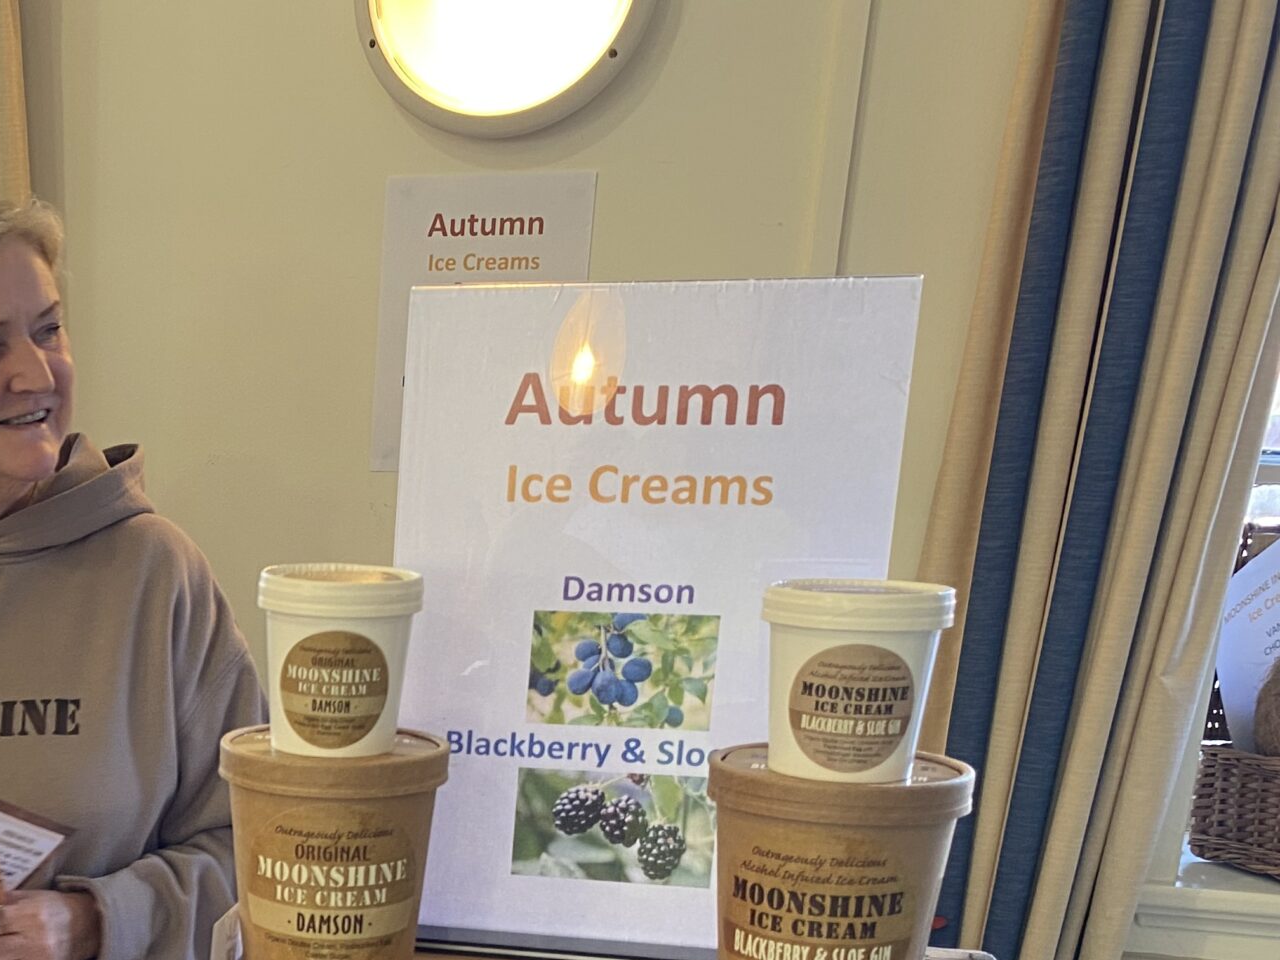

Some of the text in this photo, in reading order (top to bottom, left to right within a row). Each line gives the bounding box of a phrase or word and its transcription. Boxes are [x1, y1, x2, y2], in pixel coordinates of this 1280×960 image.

[427, 213, 545, 237] Autumn
[428, 253, 540, 271] Ice Creams
[504, 371, 787, 426] Autumn
[506, 464, 774, 506] Ice Creams
[562, 576, 695, 606] Damson
[1224, 580, 1271, 624] MOONSHINE
[311, 656, 355, 667] ORIGINAL
[286, 664, 382, 684] MOONSHINE
[298, 682, 367, 696] ICE CREAM
[800, 681, 909, 701] MOONSHINE
[311, 699, 351, 713] DAMSON
[814, 700, 893, 716] ICE CREAM
[800, 714, 902, 736] BLACKBERRY & SLOE GIN
[447, 731, 705, 767] Blackberry & Slo
[274, 825, 395, 844] Outrageously Delicious
[294, 844, 370, 863] ORIGINAL
[751, 846, 887, 869] Outrageously Delicious
[256, 855, 407, 888] MOONSHINE
[739, 861, 832, 886] Alcohol Infused
[275, 884, 388, 907] ICE CREAM
[732, 874, 904, 917] MOONSHINE
[296, 912, 364, 935] DAMSON
[749, 909, 877, 940] ICE CREAM
